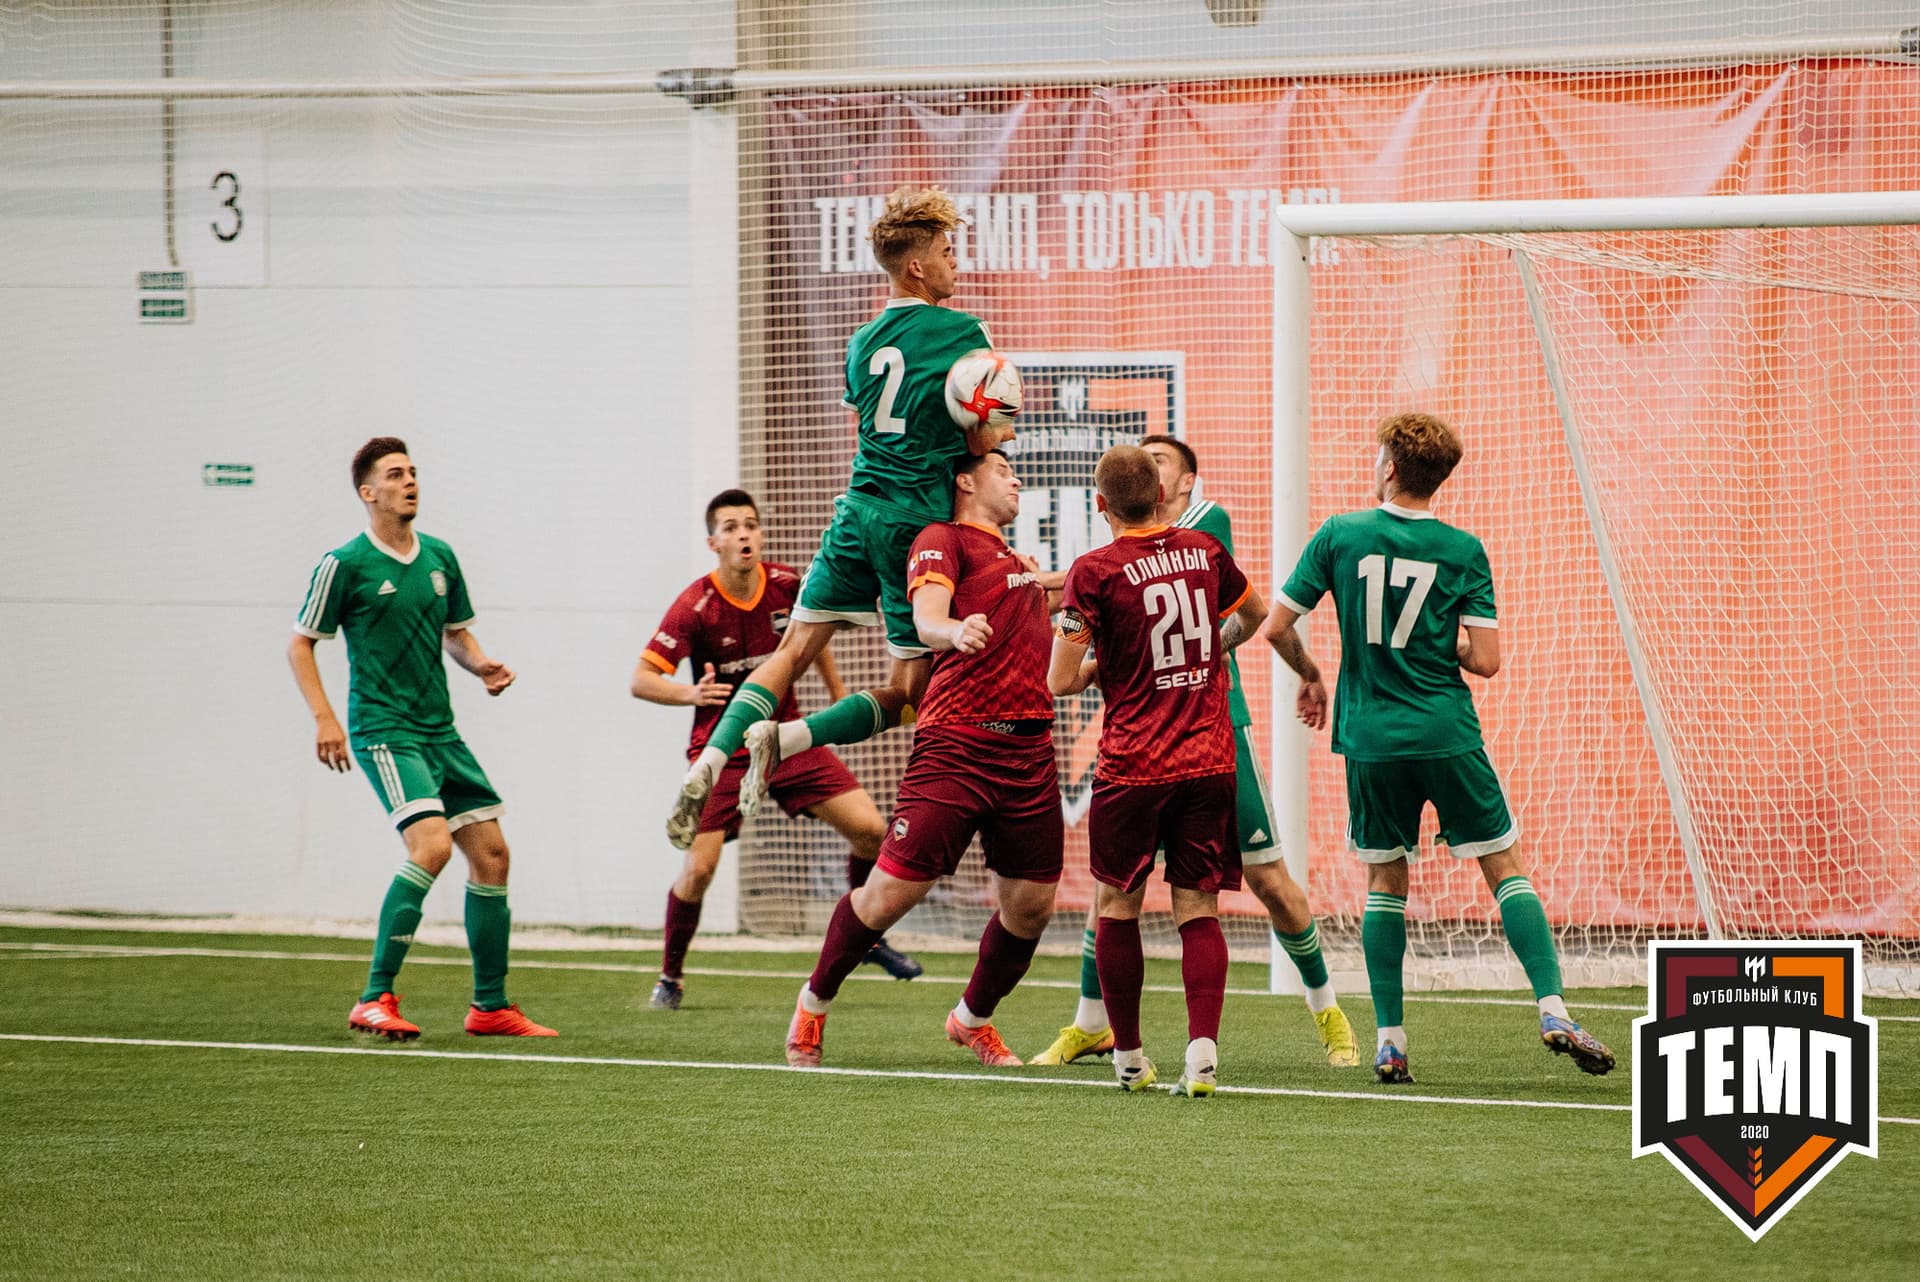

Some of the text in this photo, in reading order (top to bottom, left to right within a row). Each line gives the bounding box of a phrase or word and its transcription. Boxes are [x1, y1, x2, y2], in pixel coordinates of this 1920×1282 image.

[210, 172, 243, 243] 3
[945, 192, 1049, 280] ЕМП,
[1060, 189, 1214, 271] ТОЛЬКО
[869, 346, 906, 434] 2
[1122, 547, 1211, 586] ОЛИЙНЫК
[1358, 554, 1438, 649] 17
[1143, 578, 1212, 671] 24
